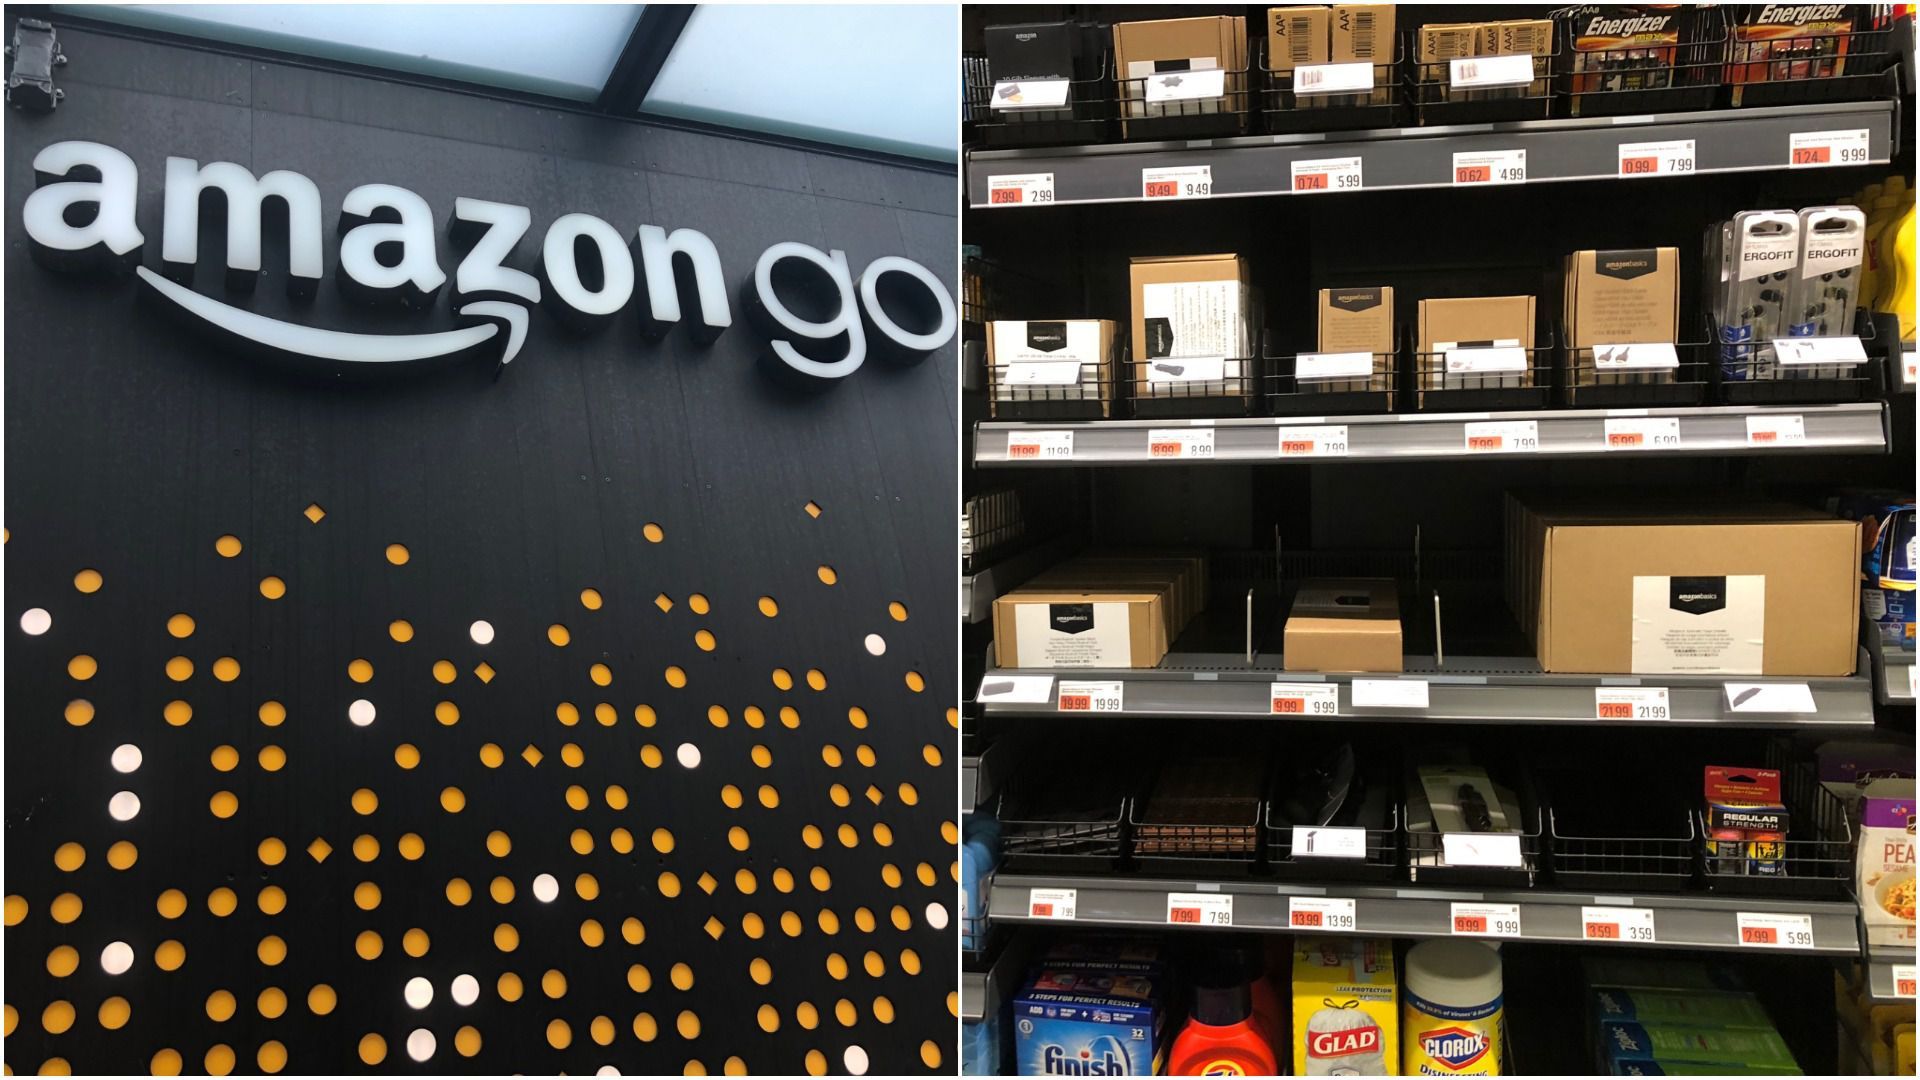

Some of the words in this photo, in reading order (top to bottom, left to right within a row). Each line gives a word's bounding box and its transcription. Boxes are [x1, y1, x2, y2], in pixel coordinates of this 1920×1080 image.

[1757, 4, 1846, 25] Energizer
[1584, 14, 1672, 38] Energizer
[1015, 32, 1037, 42] amazon
[22, 140, 731, 329] amazon
[755, 241, 957, 378] go
[1744, 250, 1794, 261] ERGOFIT
[1808, 248, 1859, 259] ERGOFIT
[1606, 260, 1648, 270] amazonbasics
[1679, 593, 1717, 602] amazonbasics
[1723, 813, 1778, 823] REGULAR
[1723, 821, 1778, 829] STRENGTH
[1074, 996, 1106, 1004] PERFECT
[1107, 999, 1140, 1008] RESULTS
[1029, 1006, 1043, 1015] ADD
[1131, 1028, 1144, 1038] 32
[1314, 1031, 1376, 1054] GLAD
[1425, 1034, 1484, 1058] CLOROX
[1045, 1045, 1124, 1076] finish
